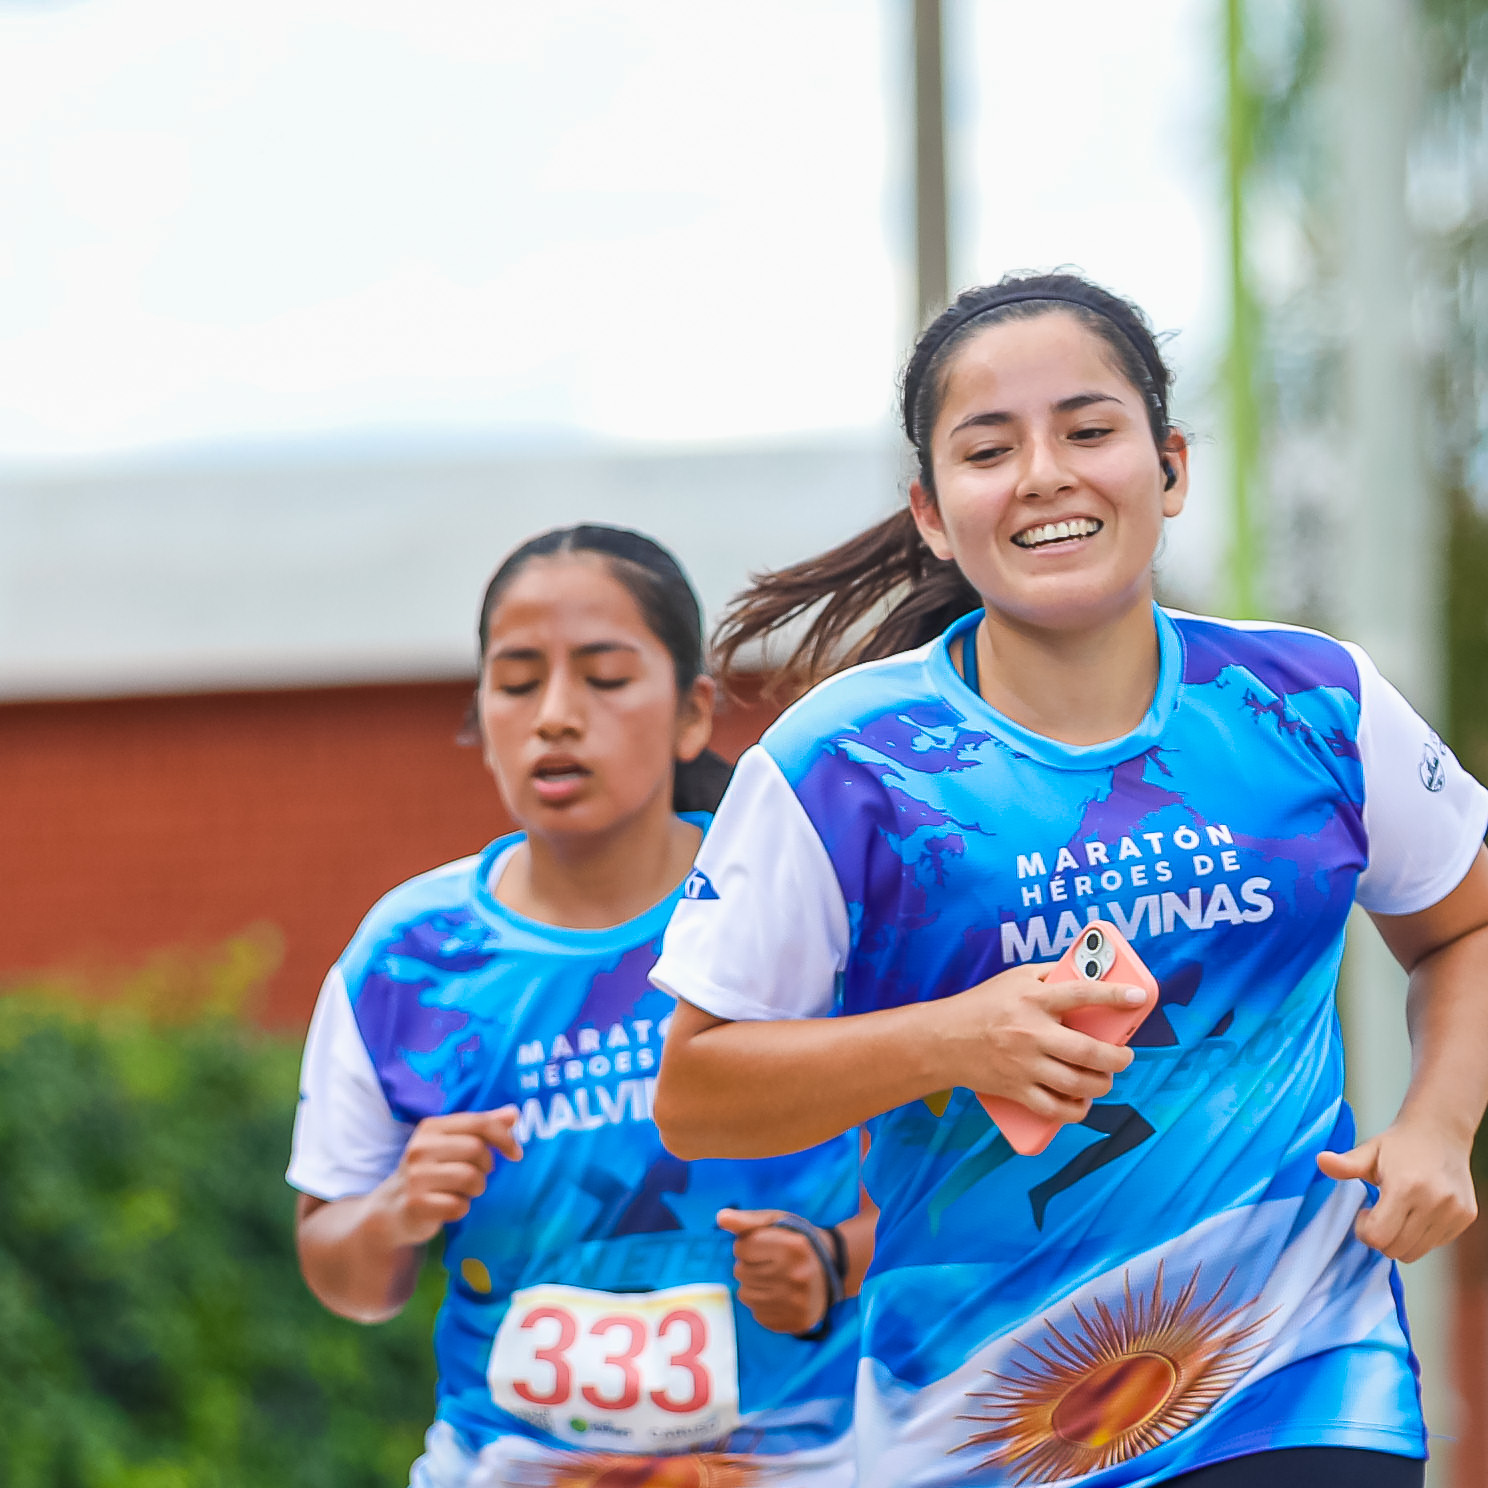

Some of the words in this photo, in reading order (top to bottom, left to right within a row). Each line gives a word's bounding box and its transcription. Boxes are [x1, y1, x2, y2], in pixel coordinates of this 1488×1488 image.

[1016, 824, 1234, 879] MARATÓN
[1021, 861, 1173, 907] HÉROES
[1192, 850, 1241, 876] DE
[512, 1306, 711, 1413] 333
